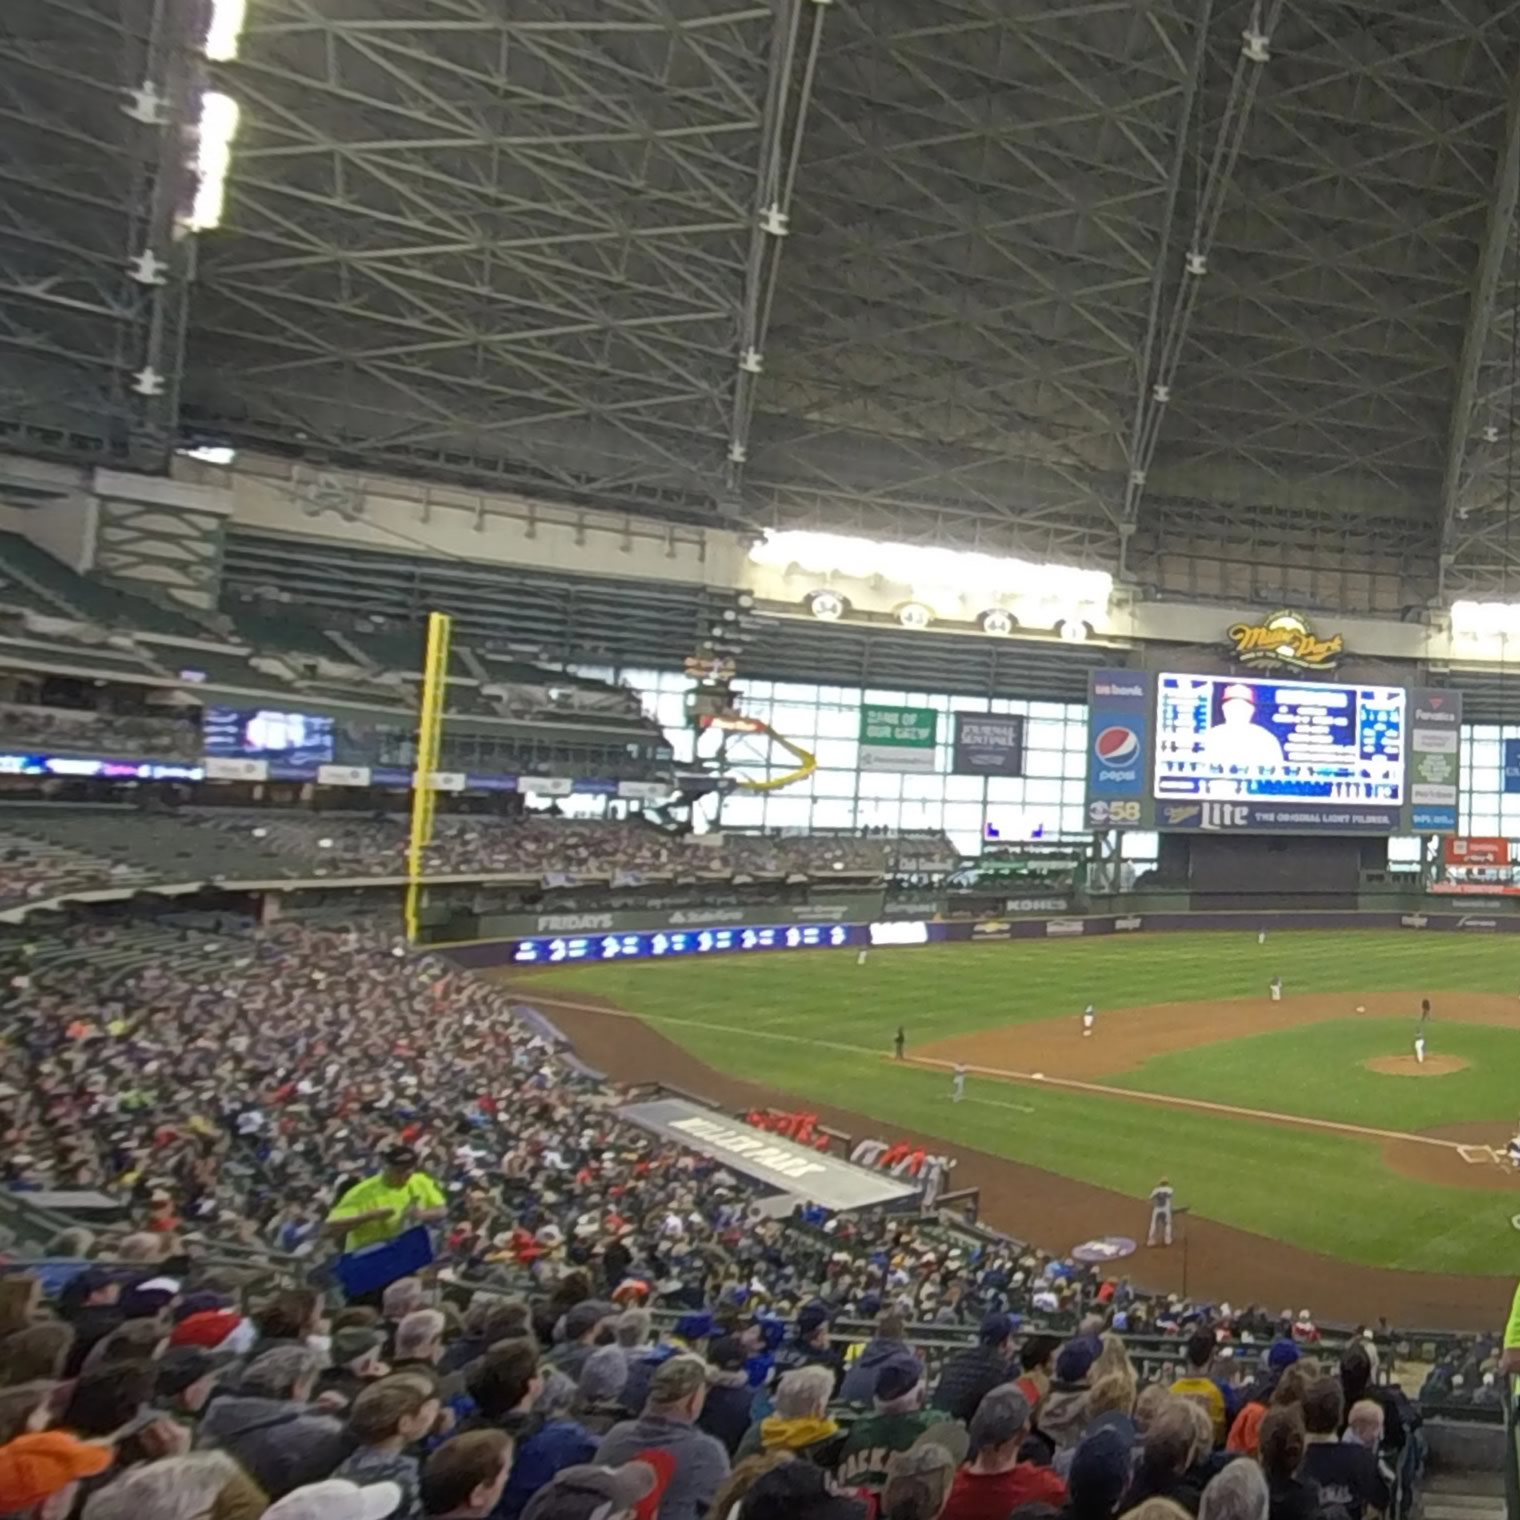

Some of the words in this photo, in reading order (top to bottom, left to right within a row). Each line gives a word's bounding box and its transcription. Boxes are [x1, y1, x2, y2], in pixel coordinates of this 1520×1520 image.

[901, 713, 918, 726] OF
[1099, 770, 1136, 782] pepsi
[1108, 801, 1141, 821] 58
[1200, 802, 1249, 830] Lite
[1255, 812, 1275, 822] THE
[1322, 813, 1351, 823] LIGHT
